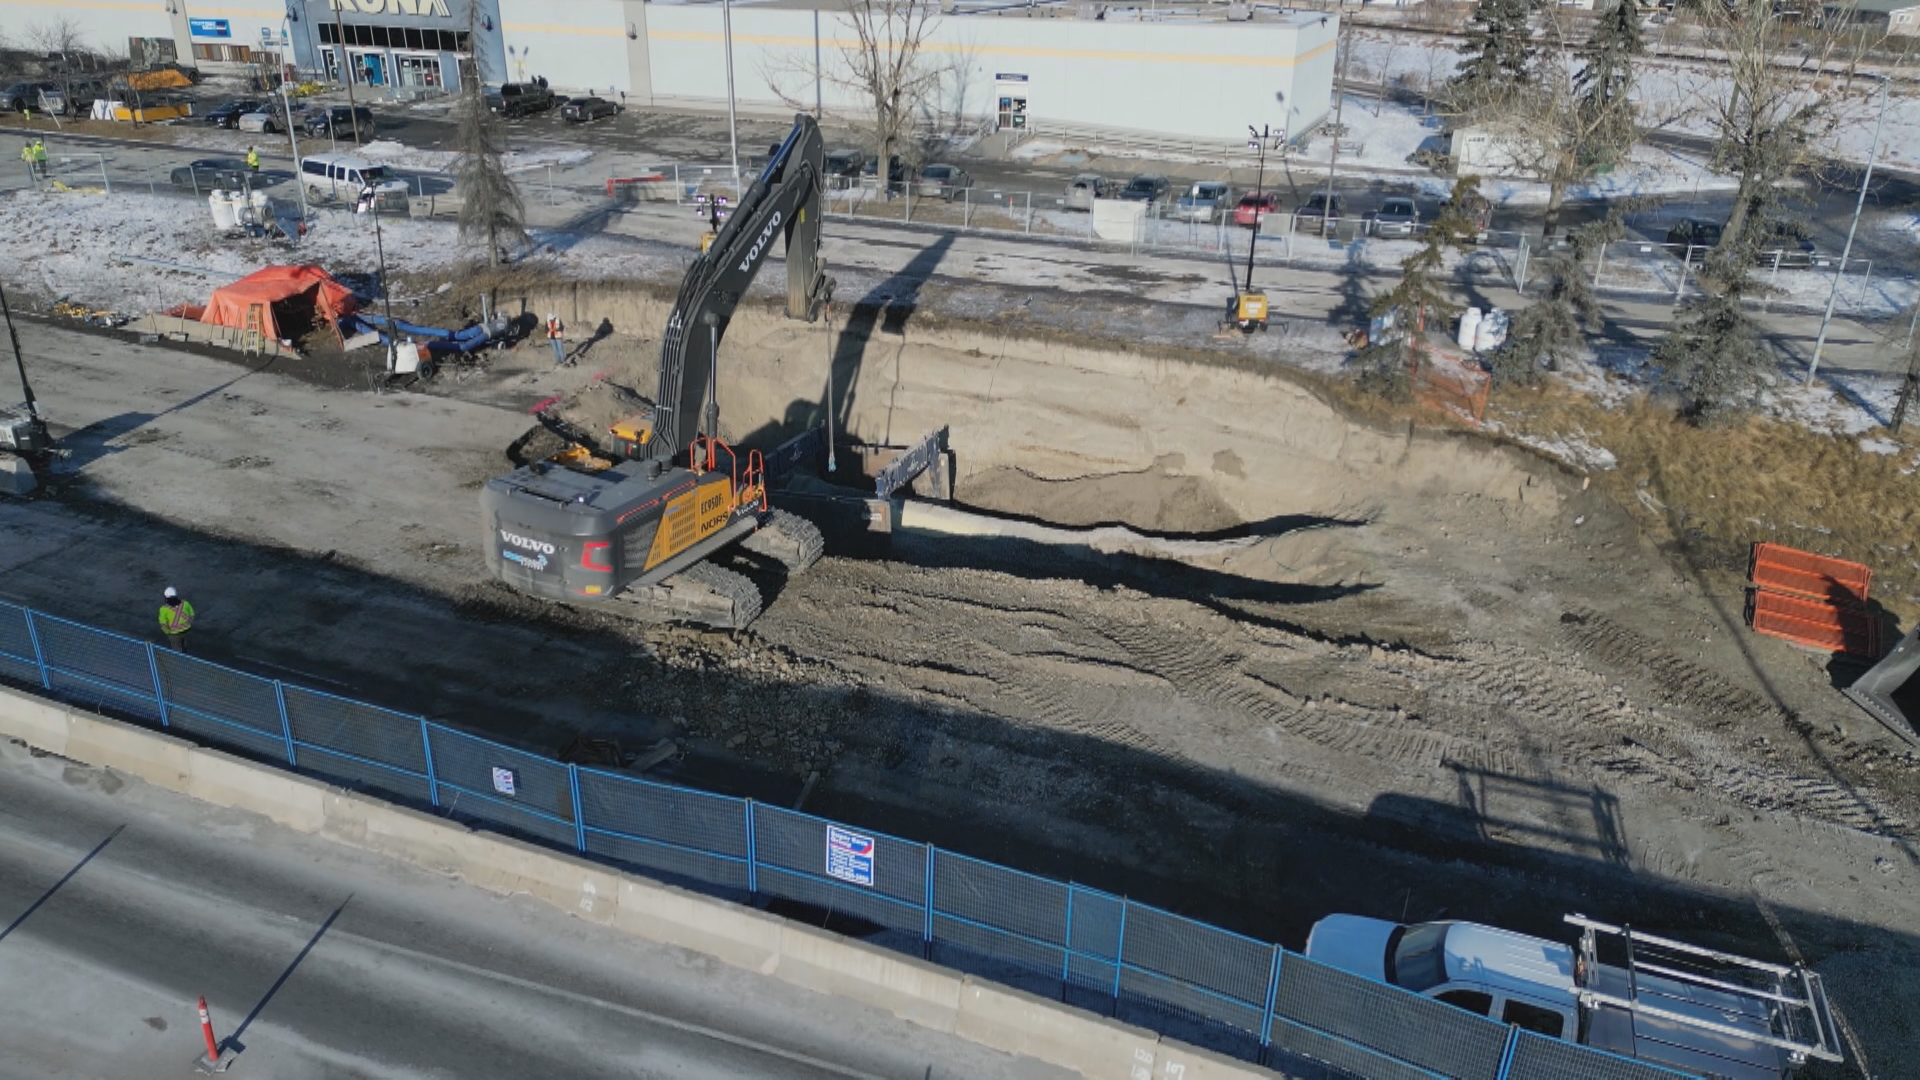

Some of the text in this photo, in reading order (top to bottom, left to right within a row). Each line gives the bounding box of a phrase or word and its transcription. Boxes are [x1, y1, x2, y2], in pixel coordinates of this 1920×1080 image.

[738, 210, 782, 273] VOLVO
[701, 511, 729, 534] NORS
[500, 529, 555, 554] VOLVO
